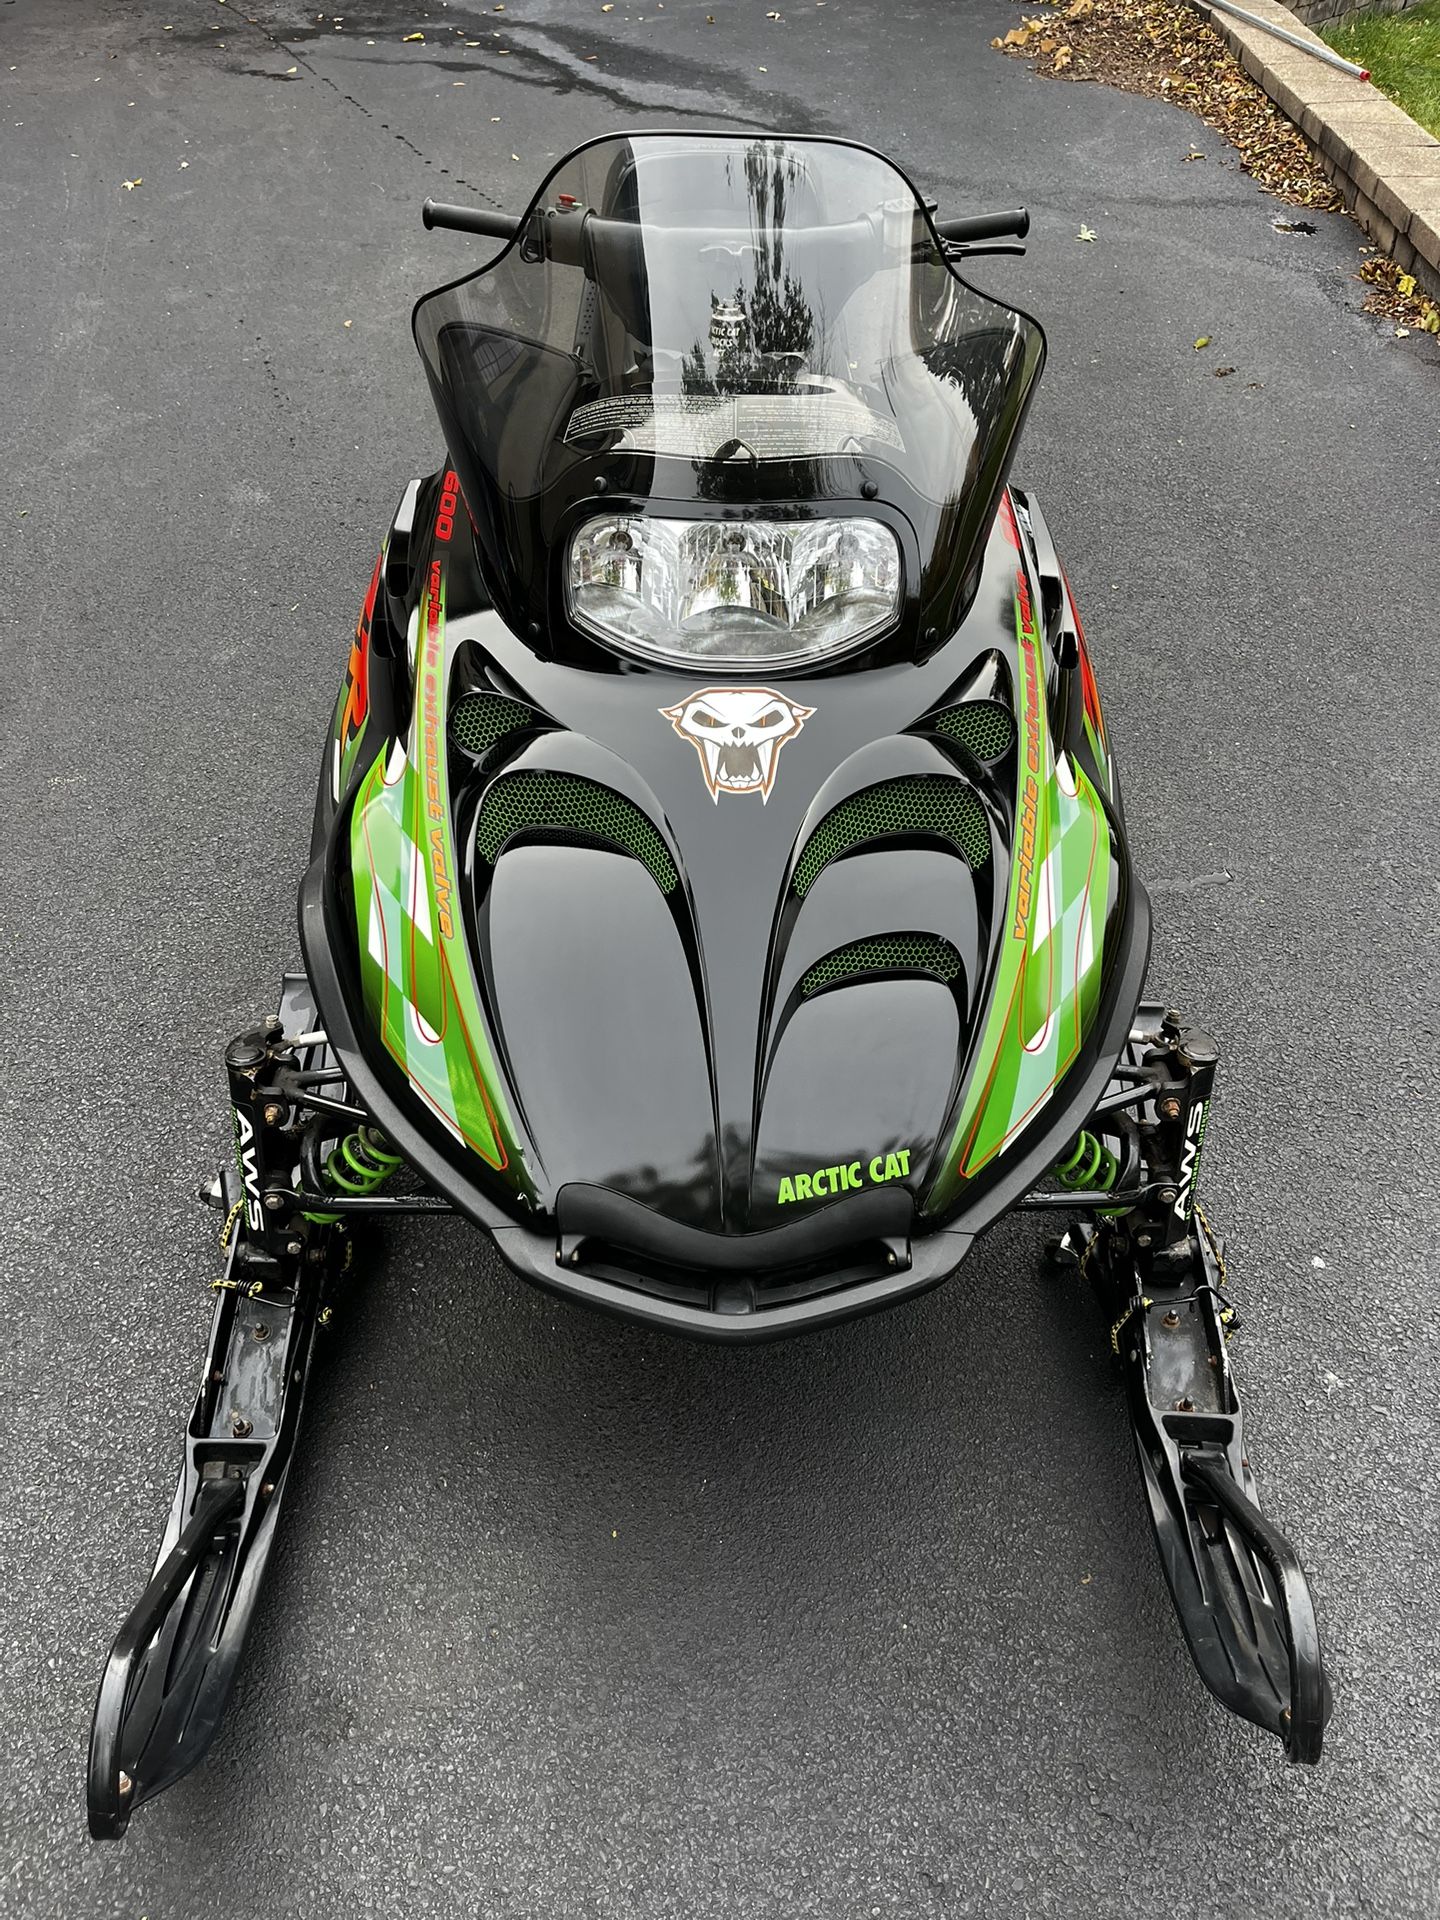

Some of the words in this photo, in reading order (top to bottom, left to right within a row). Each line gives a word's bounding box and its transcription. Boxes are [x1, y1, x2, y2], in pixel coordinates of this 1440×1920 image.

[434, 470, 459, 542] 600
[424, 560, 444, 669] variable
[1015, 568, 1035, 635] valve
[423, 673, 445, 822] exhaust
[1019, 636, 1040, 774] exhaust
[430, 828, 454, 940] valve
[1013, 776, 1039, 940] variable
[236, 1108, 265, 1232] AWS
[777, 1160, 863, 1205] ARCTIC
[868, 1149, 912, 1184] CAT
[1173, 1101, 1204, 1221] AWS
